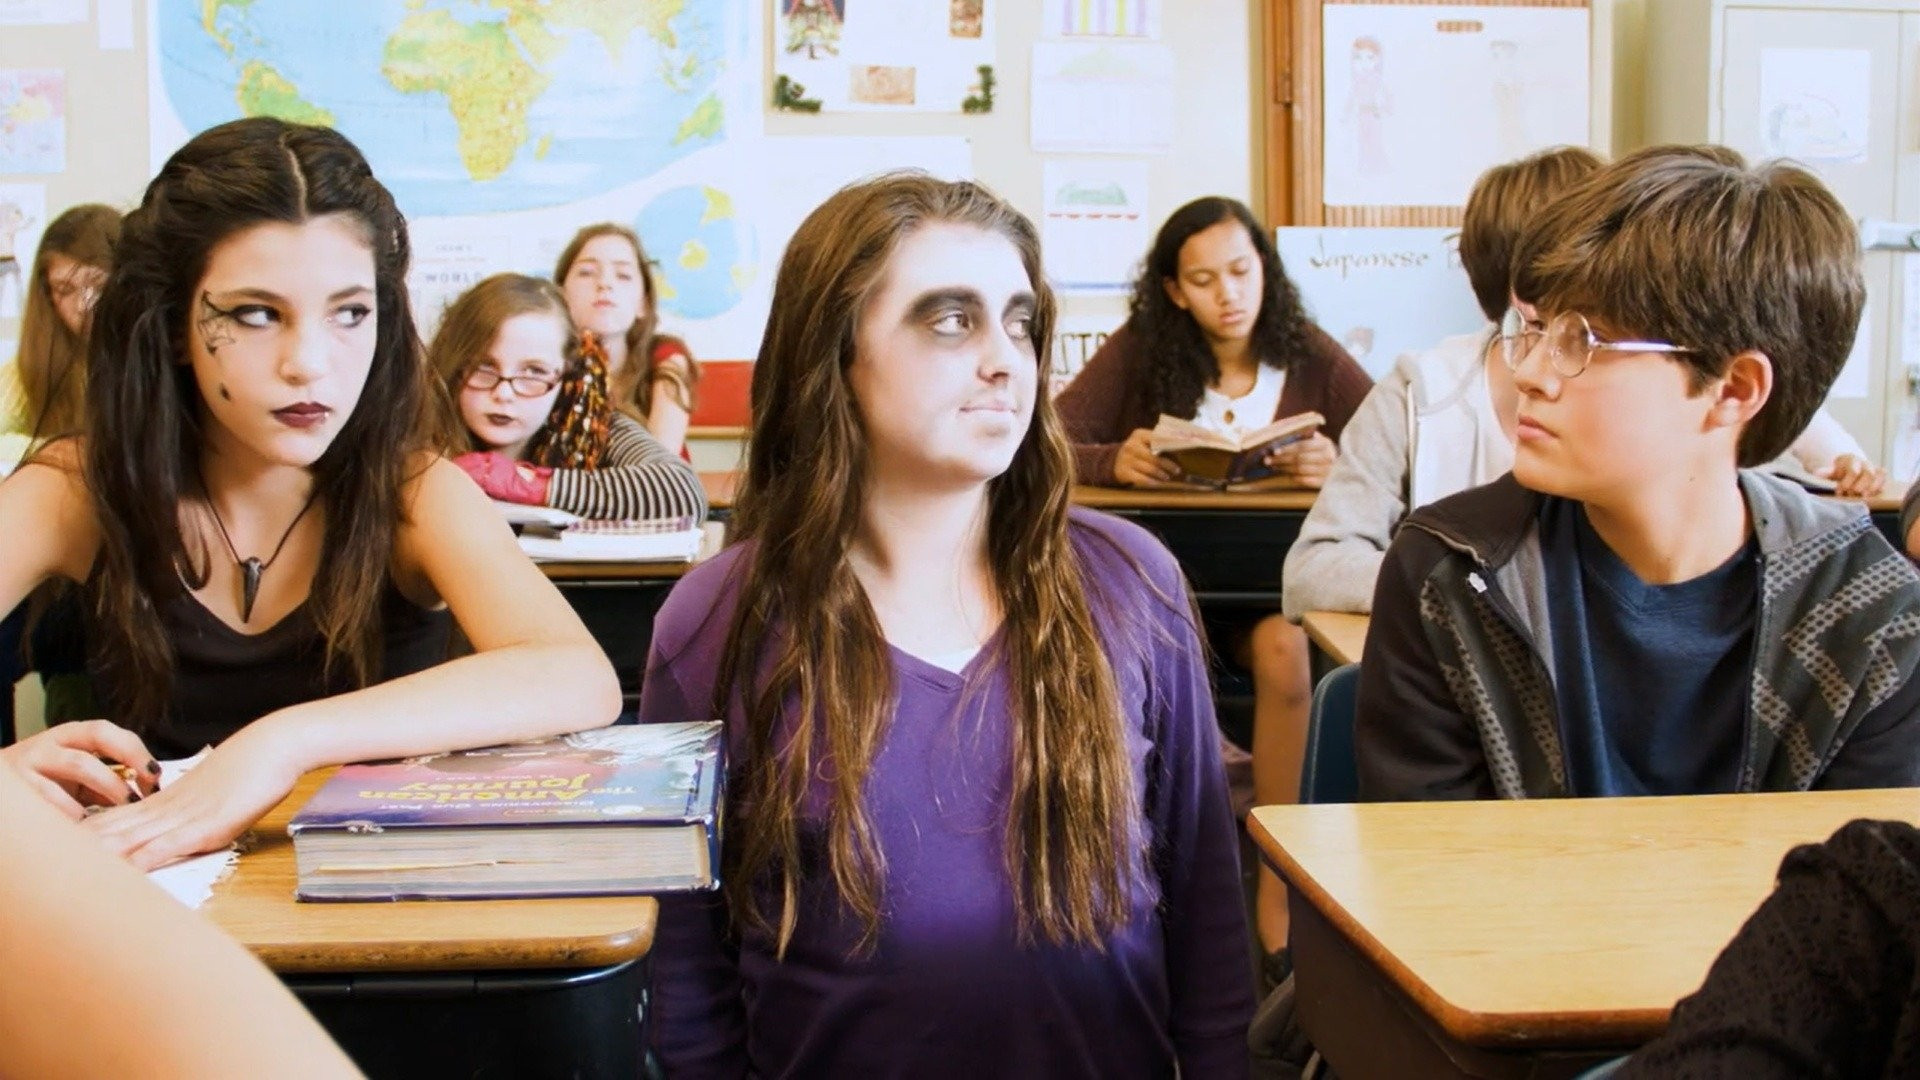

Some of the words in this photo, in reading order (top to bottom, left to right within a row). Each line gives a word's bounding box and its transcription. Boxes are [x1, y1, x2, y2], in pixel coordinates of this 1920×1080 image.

[1309, 233, 1428, 282] Japanese
[399, 773, 591, 791] Journey
[358, 789, 590, 803] American
[591, 786, 637, 795] The
